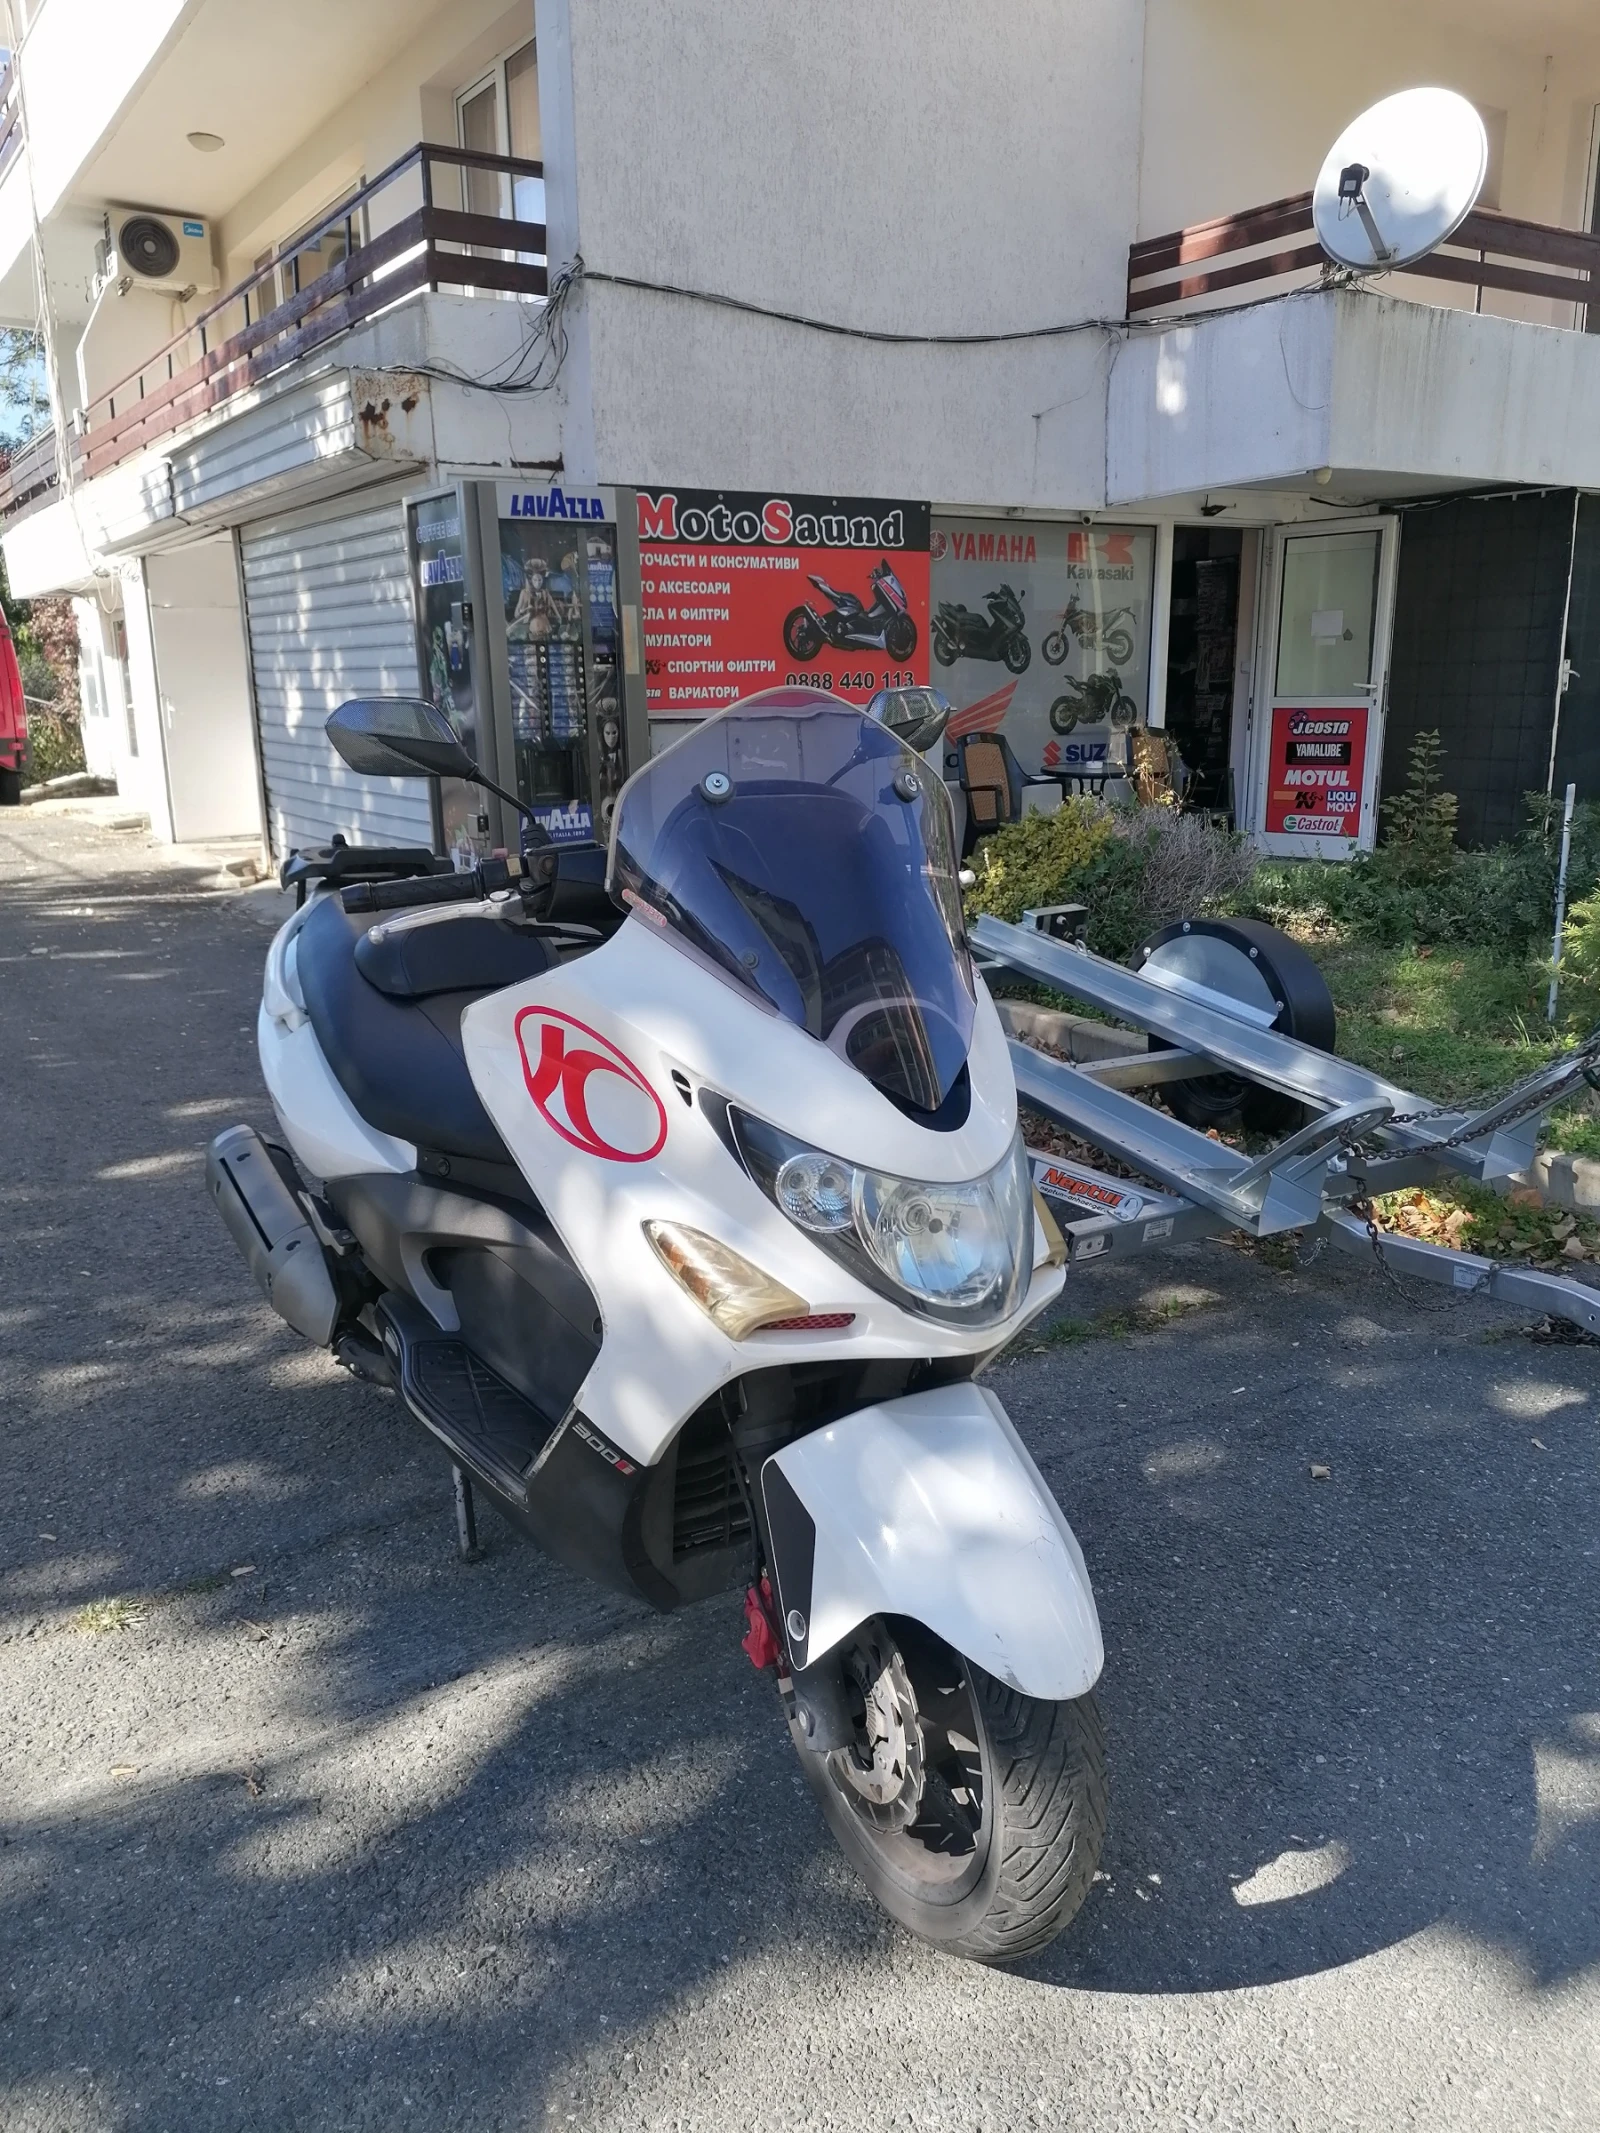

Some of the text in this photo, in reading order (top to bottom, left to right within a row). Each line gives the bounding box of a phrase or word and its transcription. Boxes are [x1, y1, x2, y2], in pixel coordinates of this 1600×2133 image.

[510, 488, 605, 520] LAVAZZA
[951, 532, 1037, 563] YAMAHA
[699, 555, 708, 567] И
[711, 555, 799, 570] КОНСУМАТИВИ
[659, 581, 731, 594] АКСЕСОАРИ
[668, 608, 677, 620] И
[680, 608, 729, 620] ФИЛТРИ
[644, 634, 712, 647] МУЛАТОРИ
[667, 660, 776, 673] СПОРТНИ ФИЛТРИ
[785, 670, 914, 690] 0888 440 113
[669, 686, 740, 699] ВАРИАТОРИ
[1296, 744, 1342, 757] YAMALUBE
[1283, 769, 1349, 786] MOTUL
[1327, 791, 1357, 802] LIQUI
[1326, 802, 1357, 813] MOLY
[1297, 817, 1339, 831] Castrol
